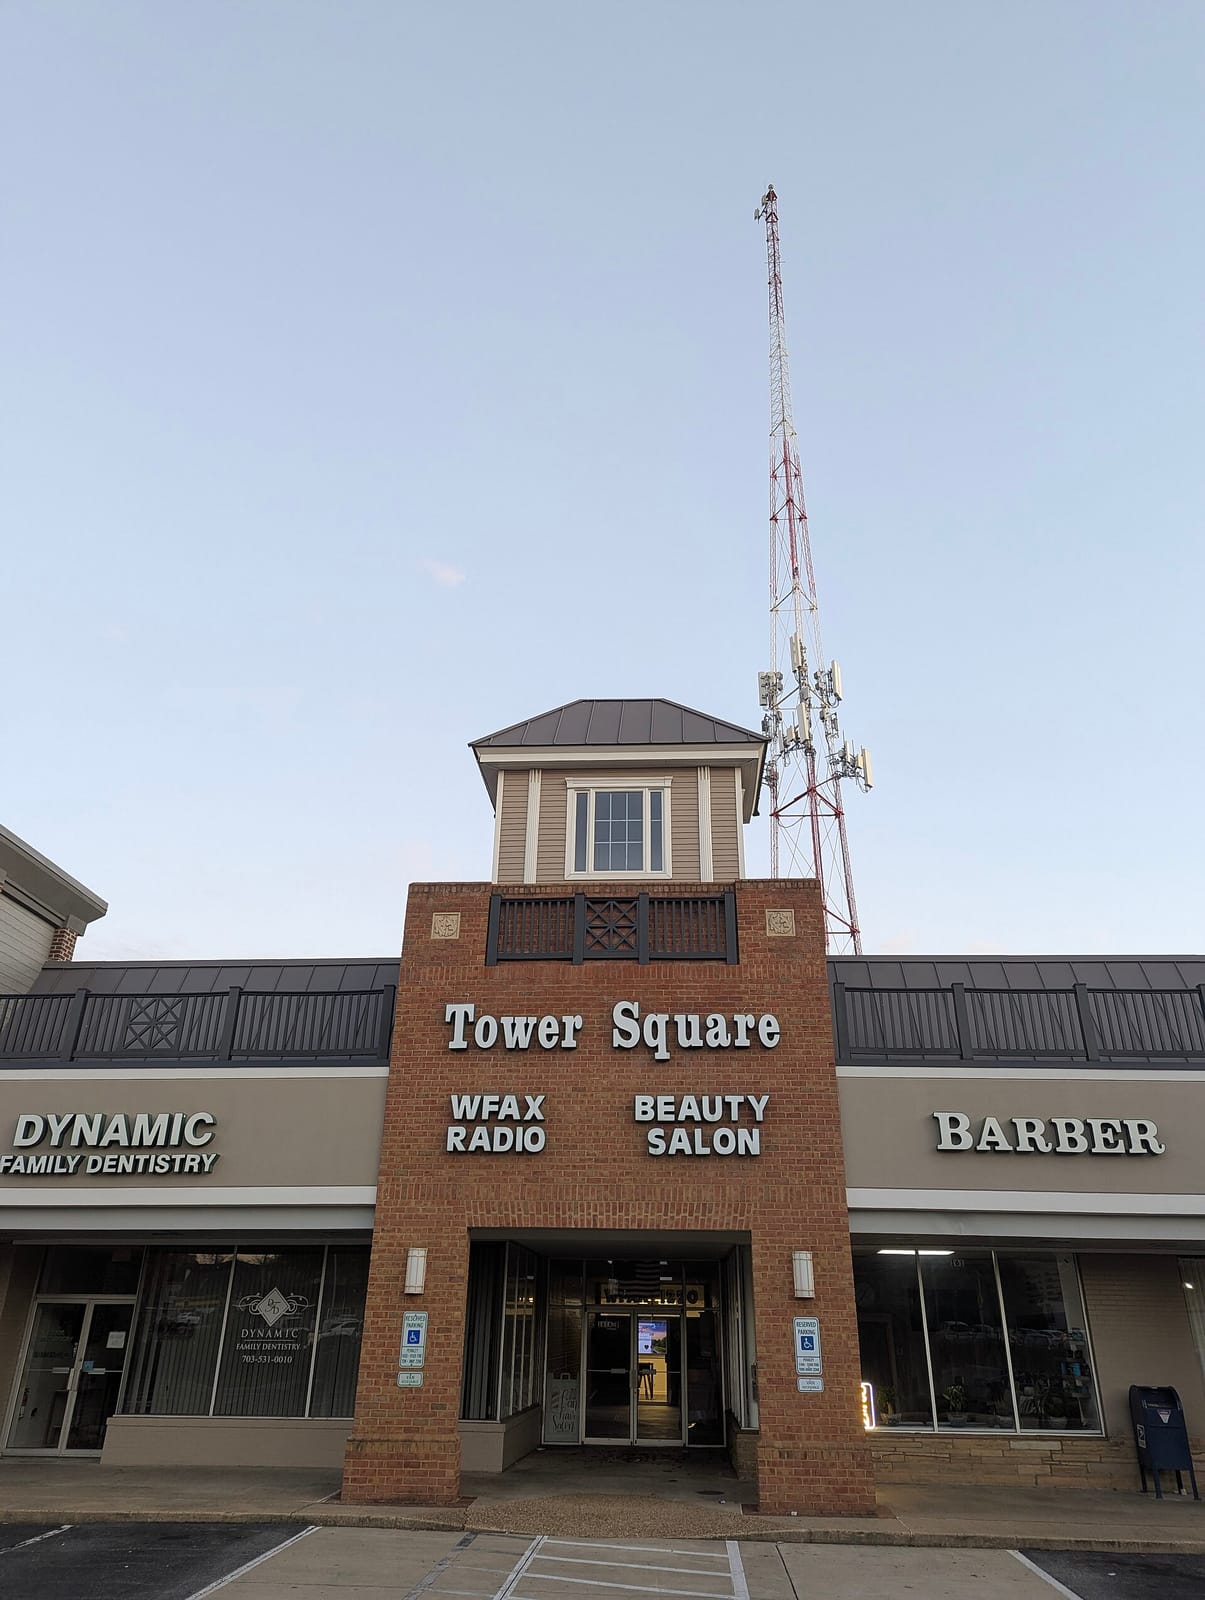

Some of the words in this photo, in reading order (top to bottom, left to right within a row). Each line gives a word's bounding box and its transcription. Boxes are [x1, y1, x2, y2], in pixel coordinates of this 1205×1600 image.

[445, 1003, 583, 1050] Tower
[612, 1001, 781, 1060] Square
[451, 1095, 547, 1121] WFAX
[634, 1095, 770, 1122] BEAUTY
[13, 1111, 216, 1148] DYNAMIC
[447, 1126, 547, 1152] RADIO
[647, 1127, 761, 1155] SALON
[933, 1111, 1166, 1156] BARBER
[0, 1155, 82, 1174] FAMILY
[86, 1153, 218, 1174] DENTISTRY
[240, 1328, 299, 1338] DYNAMIC
[236, 1343, 261, 1351] FAMILY
[262, 1343, 301, 1351] DENTISTRY
[241, 1354, 293, 1364] 703-531-0010
